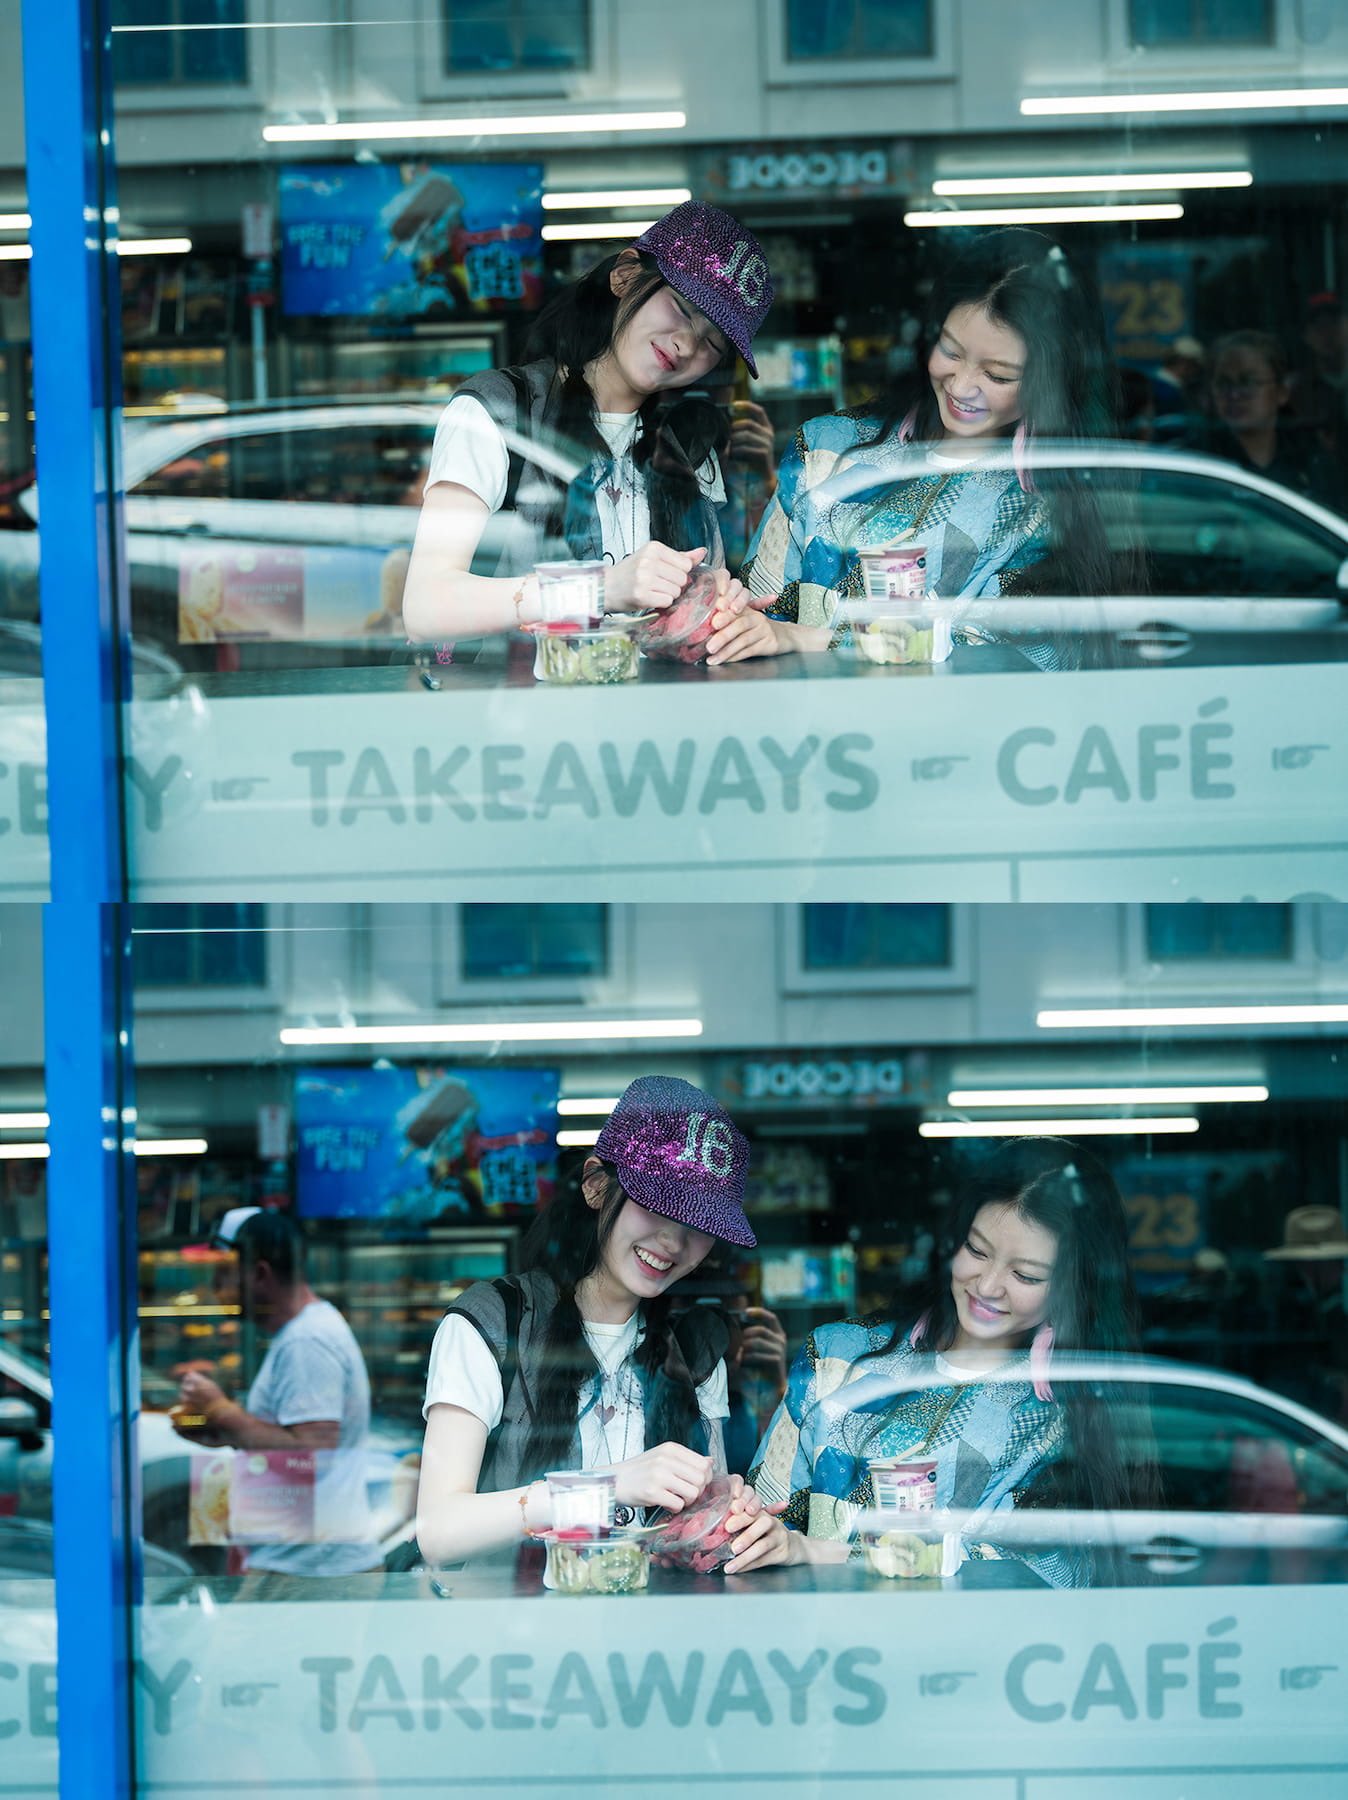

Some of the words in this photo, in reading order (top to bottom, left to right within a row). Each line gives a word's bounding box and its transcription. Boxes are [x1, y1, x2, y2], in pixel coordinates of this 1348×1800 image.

[716, 240, 767, 306] 16
[291, 733, 880, 827] TAKEAWAYS
[996, 696, 1236, 806] CAFÉ
[676, 1111, 733, 1177] 16
[299, 1646, 888, 1733] TAKEAWAYS
[1004, 1615, 1243, 1723] CAFÉ
